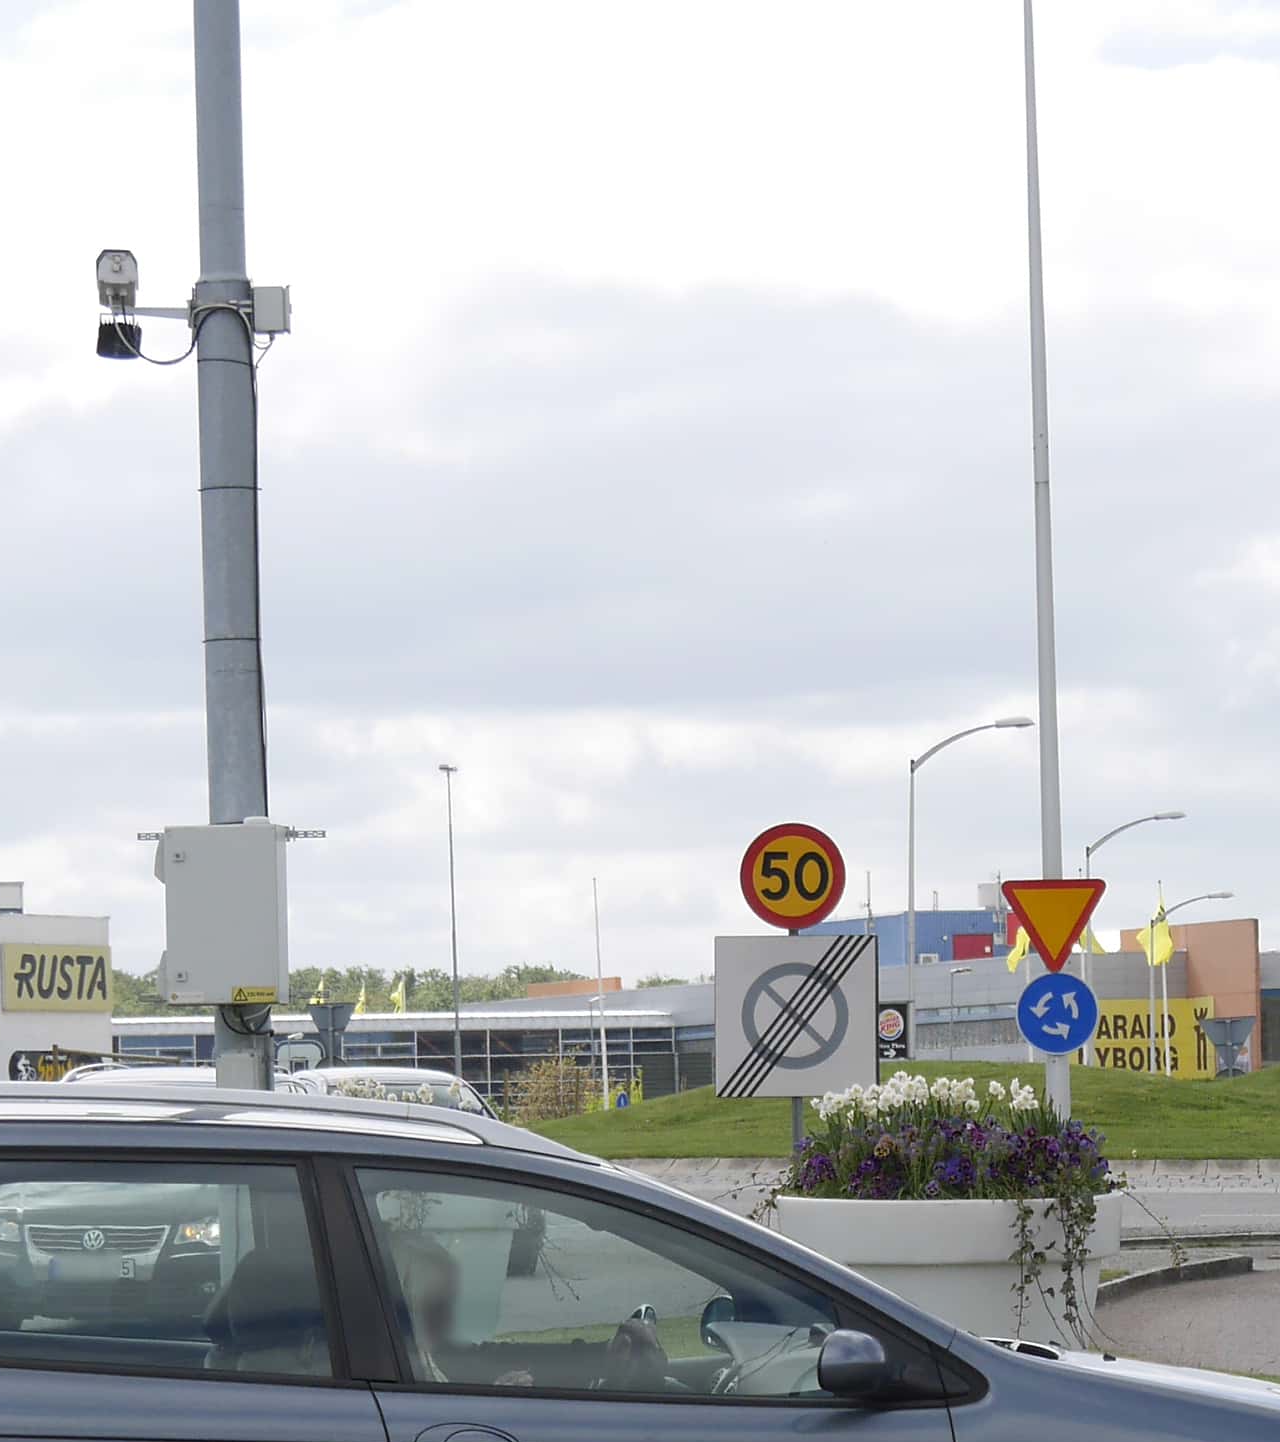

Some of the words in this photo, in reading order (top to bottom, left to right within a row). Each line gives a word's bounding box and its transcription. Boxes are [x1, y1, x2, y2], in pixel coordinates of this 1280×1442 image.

[761, 851, 829, 902] 50
[14, 953, 107, 1000] RUSTA
[1096, 1013, 1176, 1041] ARALD
[1078, 1045, 1179, 1073] YBORG
